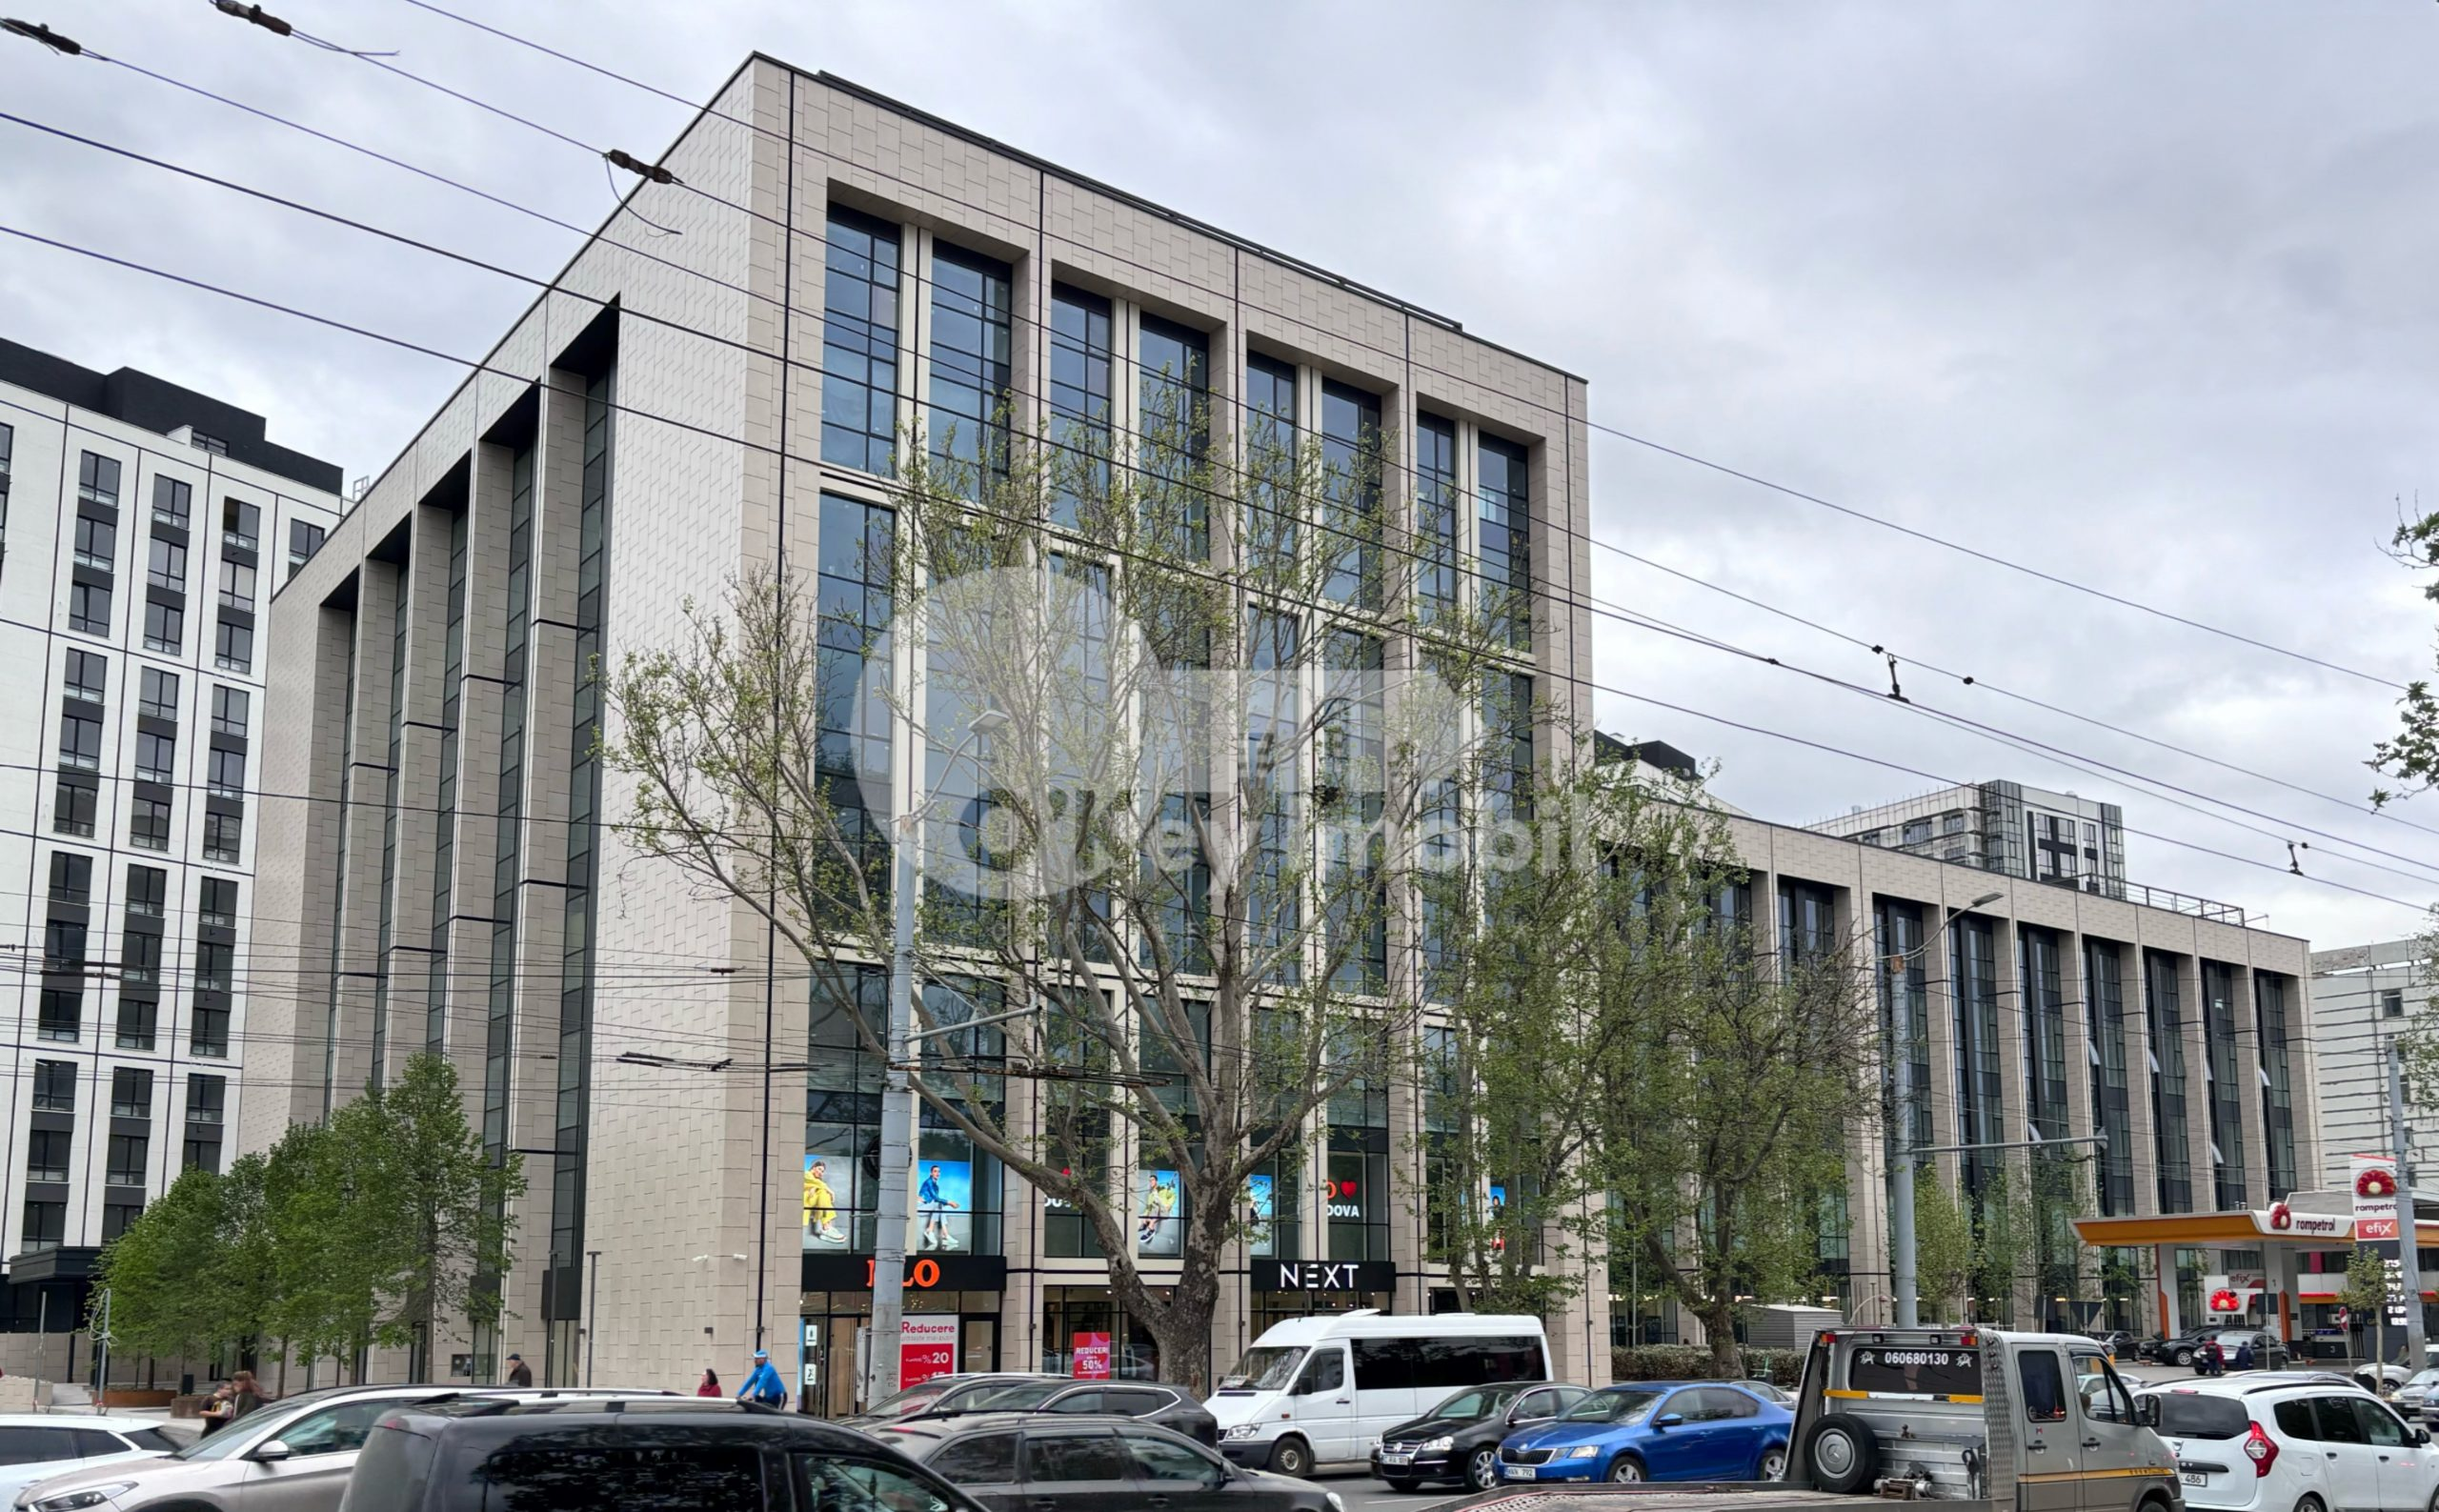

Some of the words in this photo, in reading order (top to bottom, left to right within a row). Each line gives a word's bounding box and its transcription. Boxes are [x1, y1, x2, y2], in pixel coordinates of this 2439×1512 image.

[2296, 1218, 2336, 1235] rompetrol
[2366, 1221, 2393, 1236] efix
[1280, 1263, 1360, 1288] NEXT
[901, 1321, 955, 1333] Reducere
[1885, 1352, 1948, 1364] 060680130
[1082, 1360, 1102, 1370] 50%
[2185, 1474, 2202, 1484] 486
